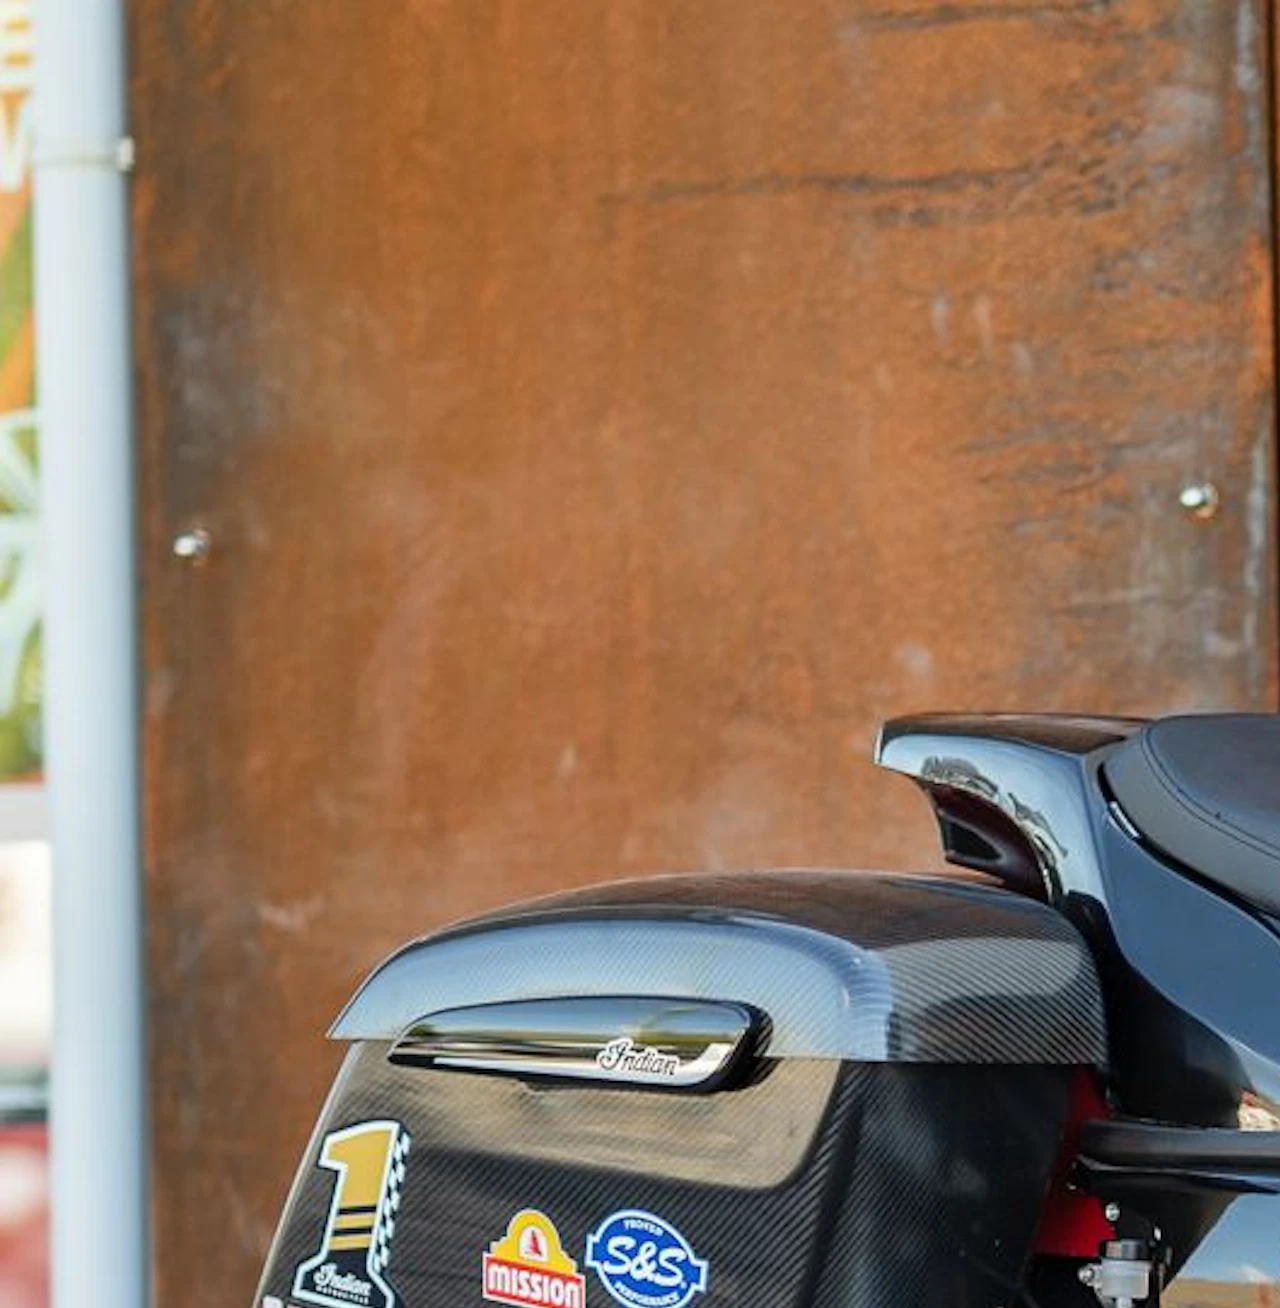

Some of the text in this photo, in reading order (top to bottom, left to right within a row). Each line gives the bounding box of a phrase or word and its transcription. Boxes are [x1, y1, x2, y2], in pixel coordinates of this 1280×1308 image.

[597, 1037, 680, 1077] Indian
[313, 1262, 371, 1296] Indian
[602, 1236, 687, 1288] S&S
